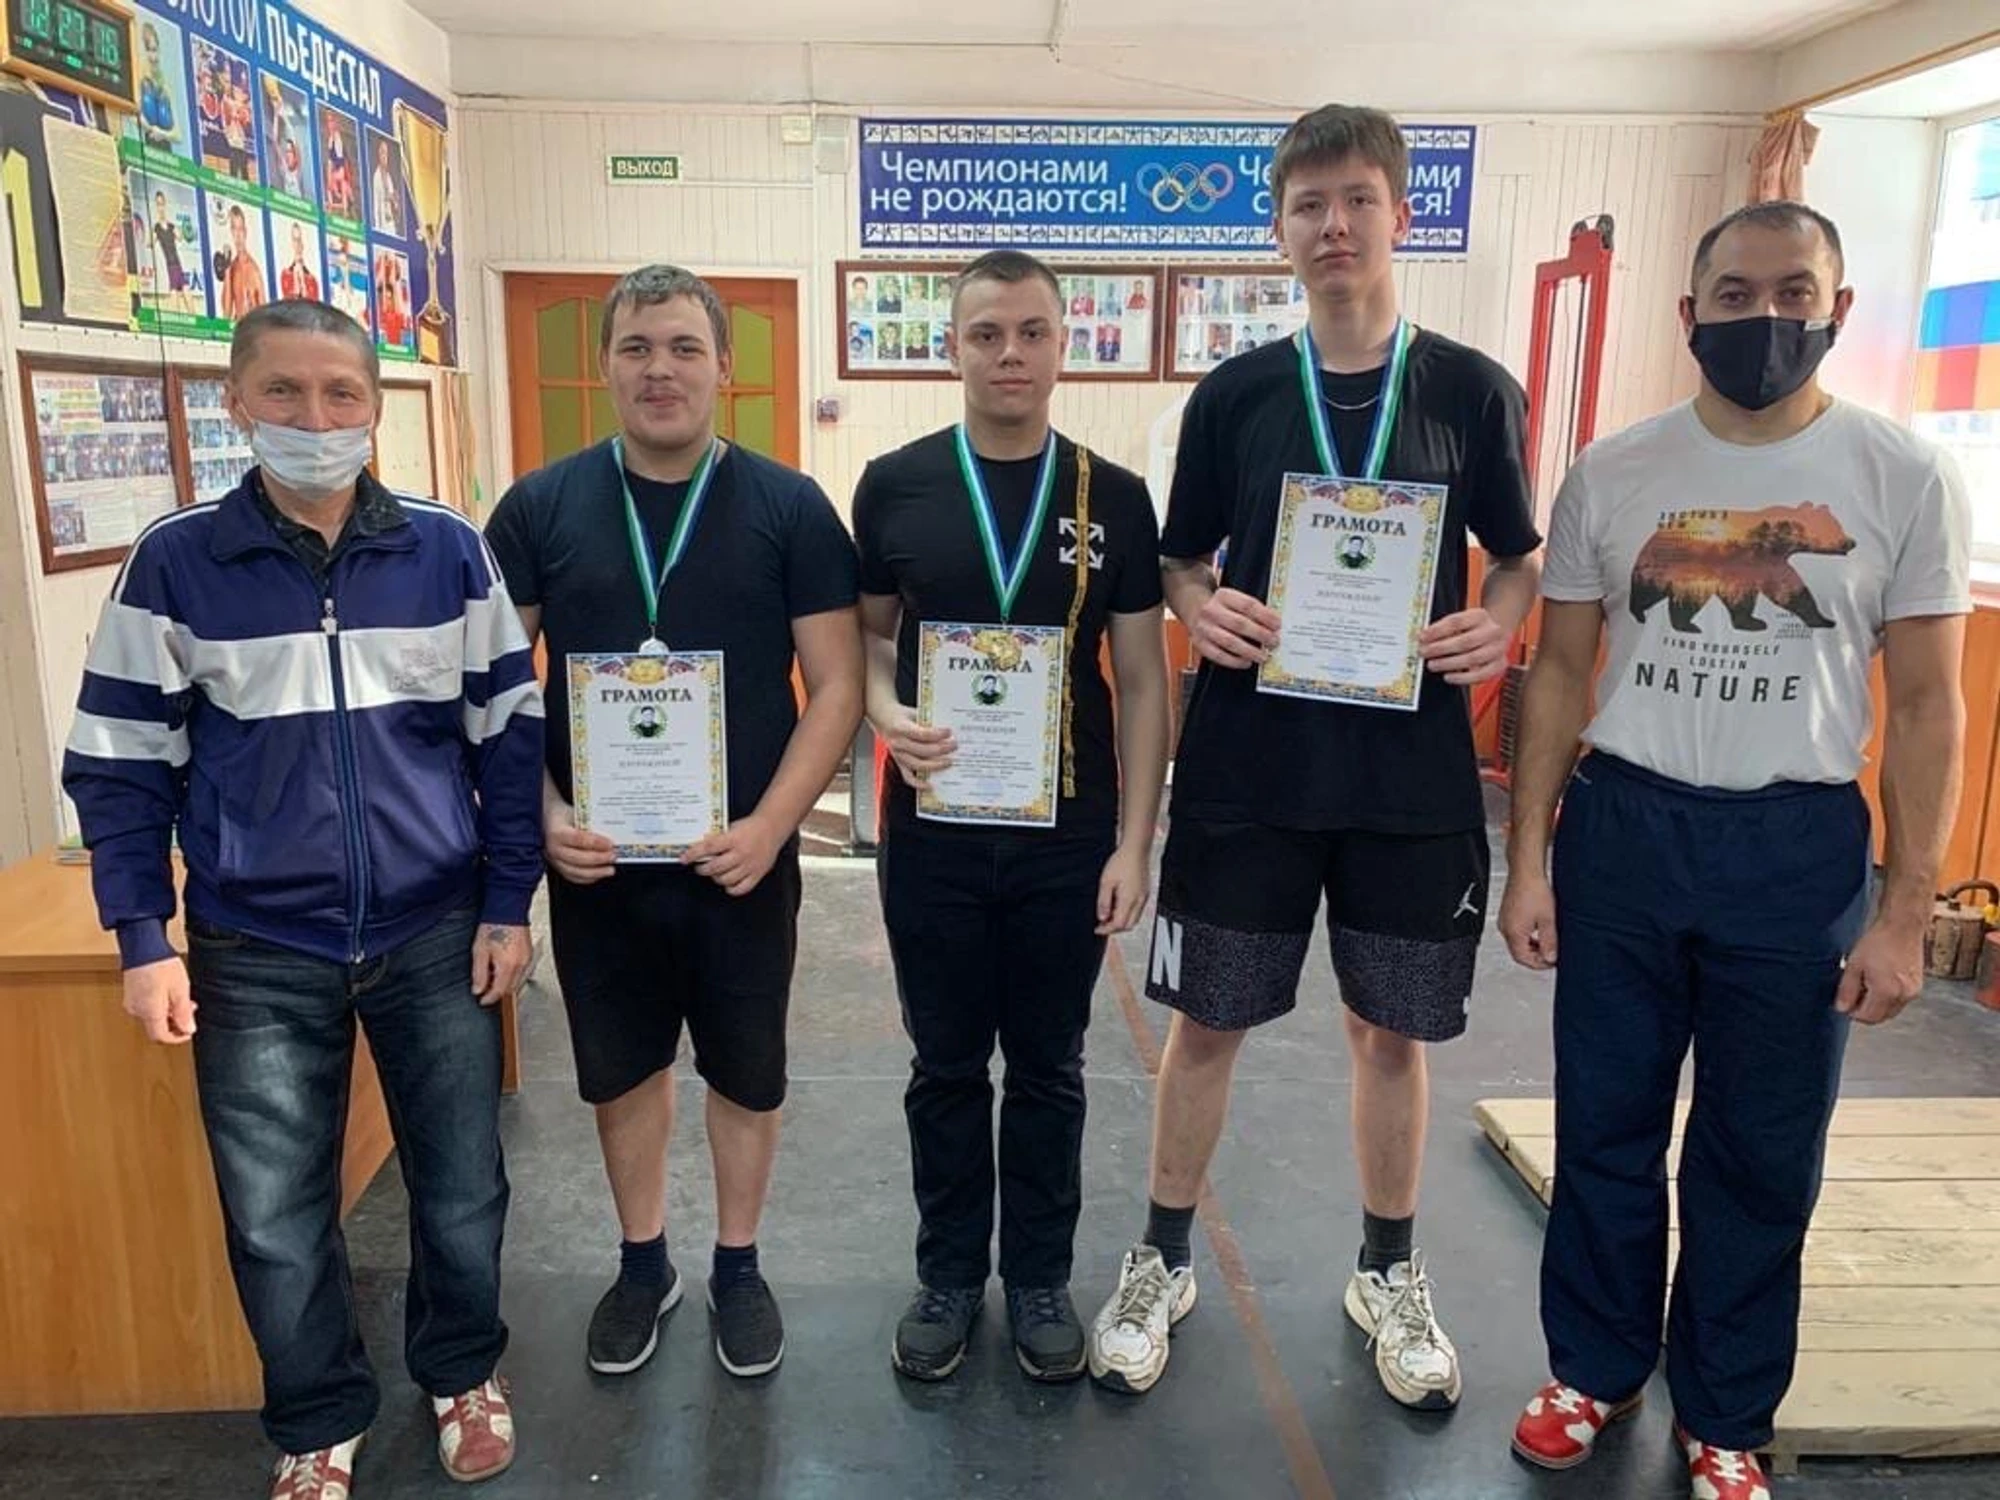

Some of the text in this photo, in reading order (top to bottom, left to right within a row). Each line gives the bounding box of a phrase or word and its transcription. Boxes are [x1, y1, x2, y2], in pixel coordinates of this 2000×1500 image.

[58, 5, 86, 51] 27
[265, 4, 383, 119] ПЬЕДЕСТАЛ
[616, 160, 675, 177] ВЫХОД
[881, 151, 1108, 183] Чемпионами
[870, 182, 1127, 218] не рождаются!
[1311, 513, 1407, 536] ГРАМОТА
[1703, 643, 1780, 655] YOURSELF
[601, 688, 692, 702] ГРАМОТА
[1635, 662, 1801, 702] NATURE
